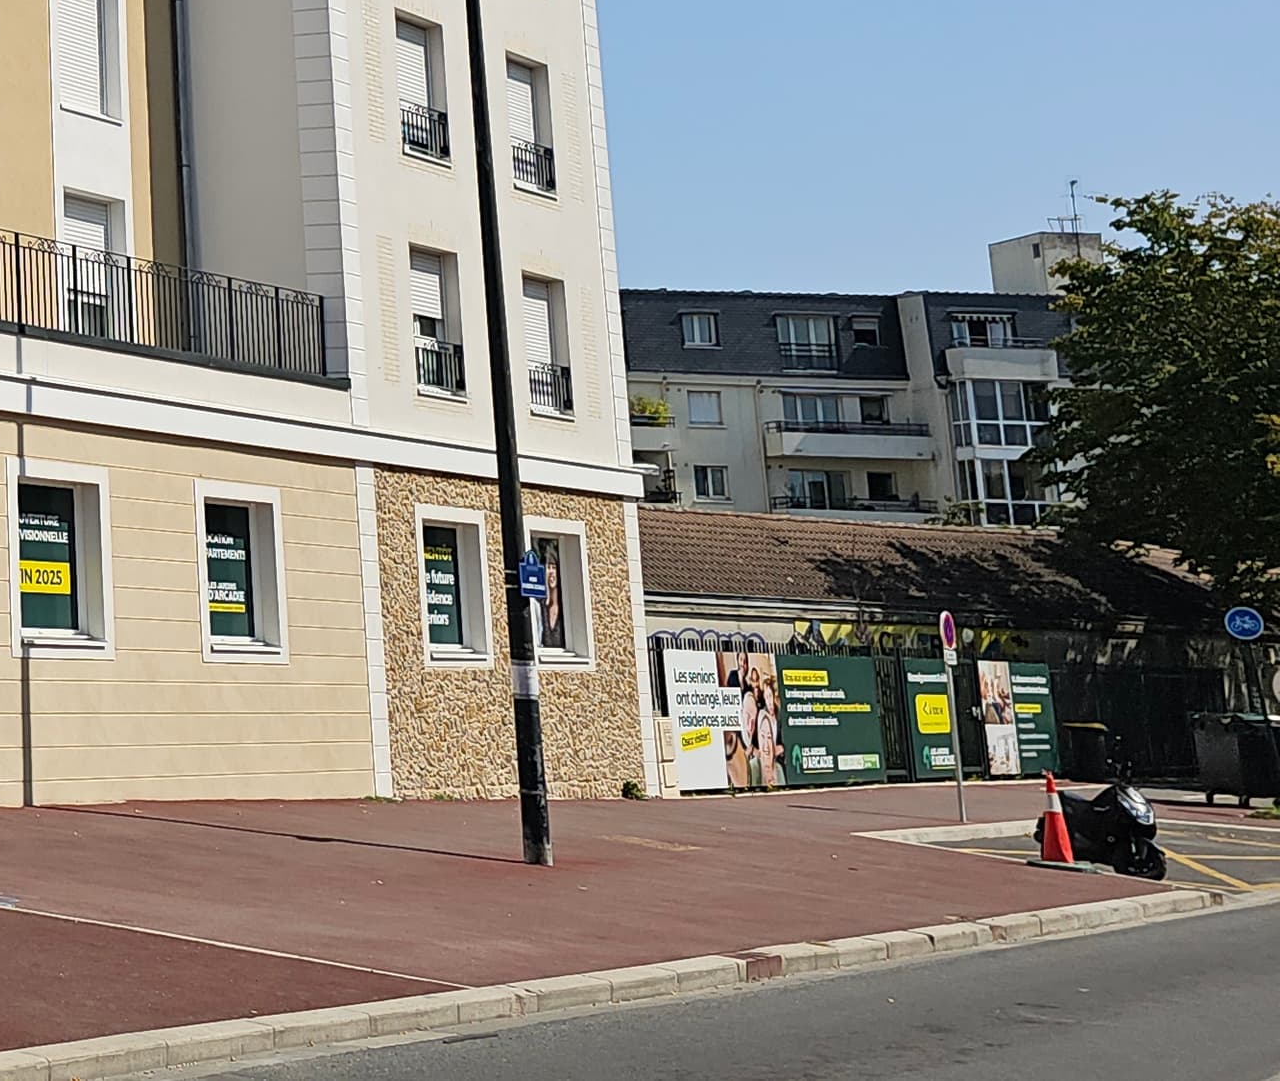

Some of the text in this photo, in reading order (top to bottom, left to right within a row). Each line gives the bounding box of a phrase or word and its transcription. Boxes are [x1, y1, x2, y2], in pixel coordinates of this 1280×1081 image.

[35, 569, 62, 586] 2025
[431, 569, 455, 585] future
[674, 667, 716, 684] Les seniors
[676, 691, 690, 705] ont
[722, 690, 740, 706] leurs
[678, 711, 720, 728] résidences
